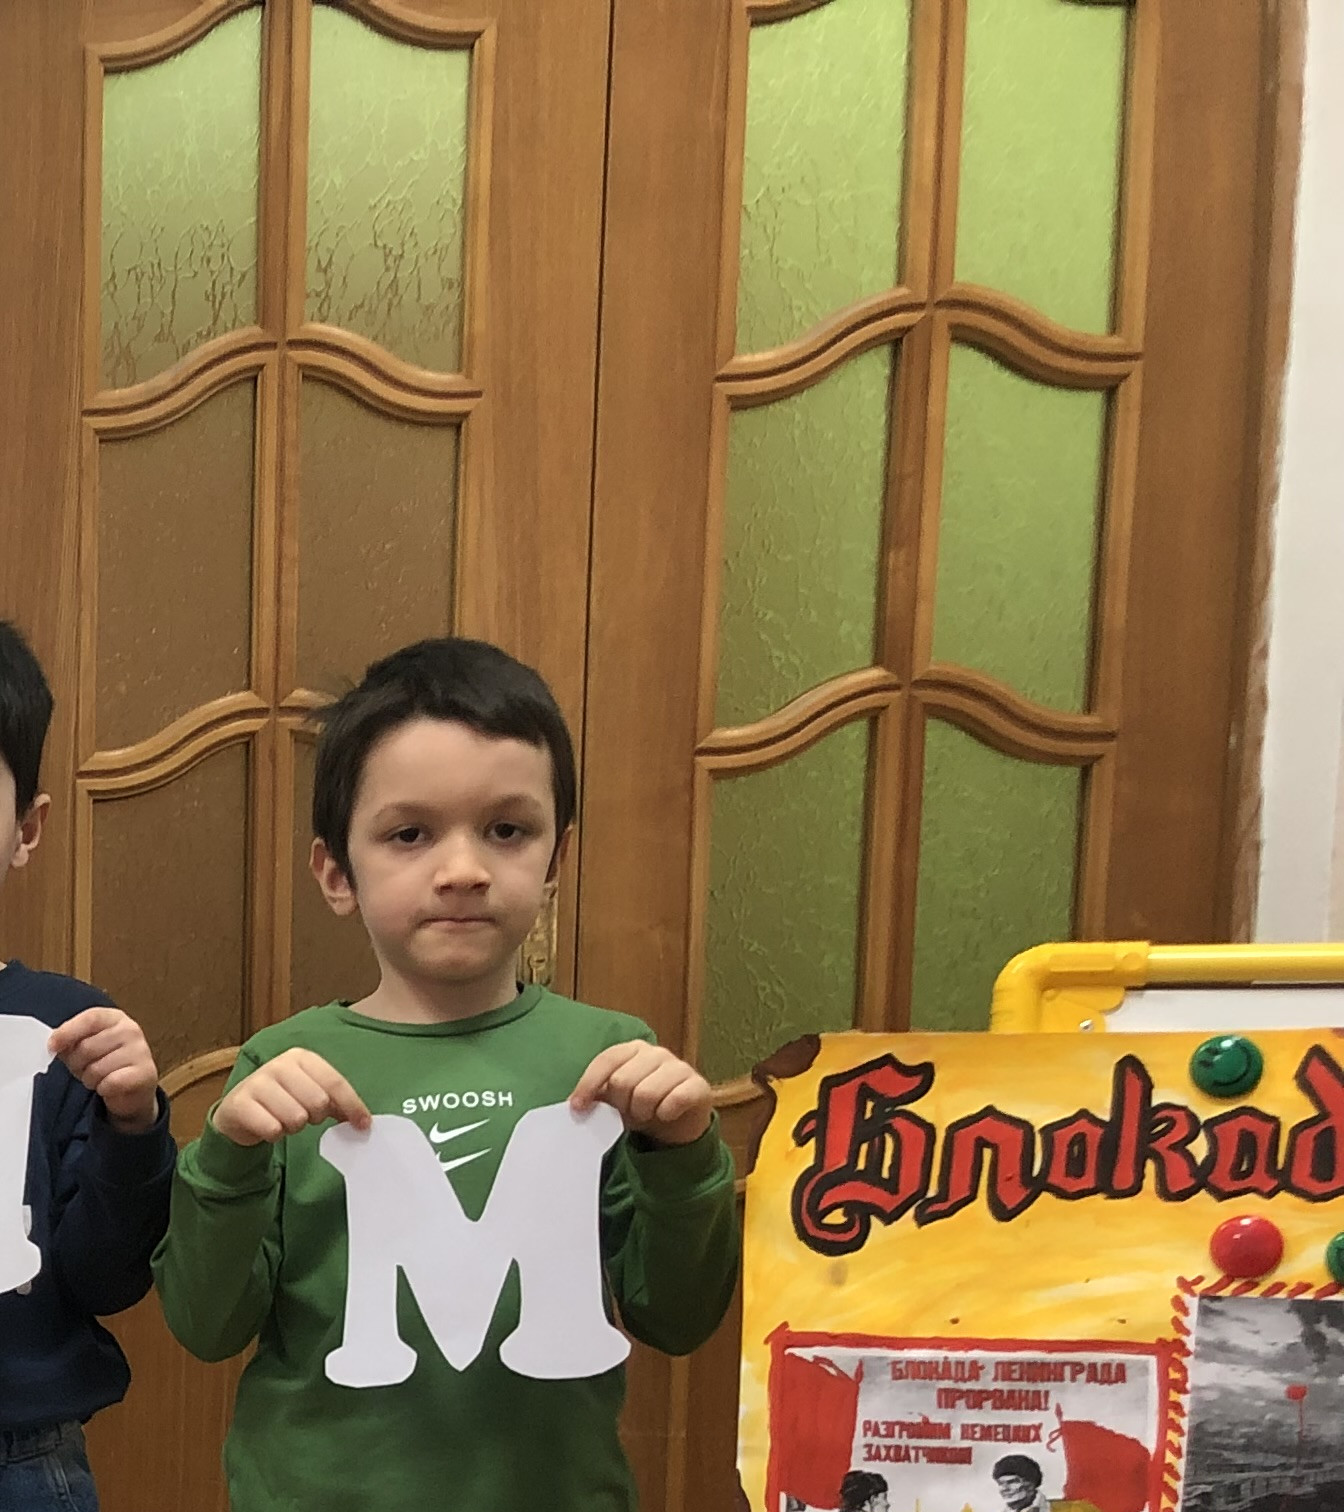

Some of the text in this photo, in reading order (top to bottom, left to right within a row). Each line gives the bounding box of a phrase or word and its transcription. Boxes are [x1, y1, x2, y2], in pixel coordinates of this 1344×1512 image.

[402, 1090, 513, 1114] SWOOSH
[889, 1359, 1127, 1385] БЛОКАДА ЛЕНИНГРАДА
[936, 1387, 1050, 1411] ПРОРВАНА!
